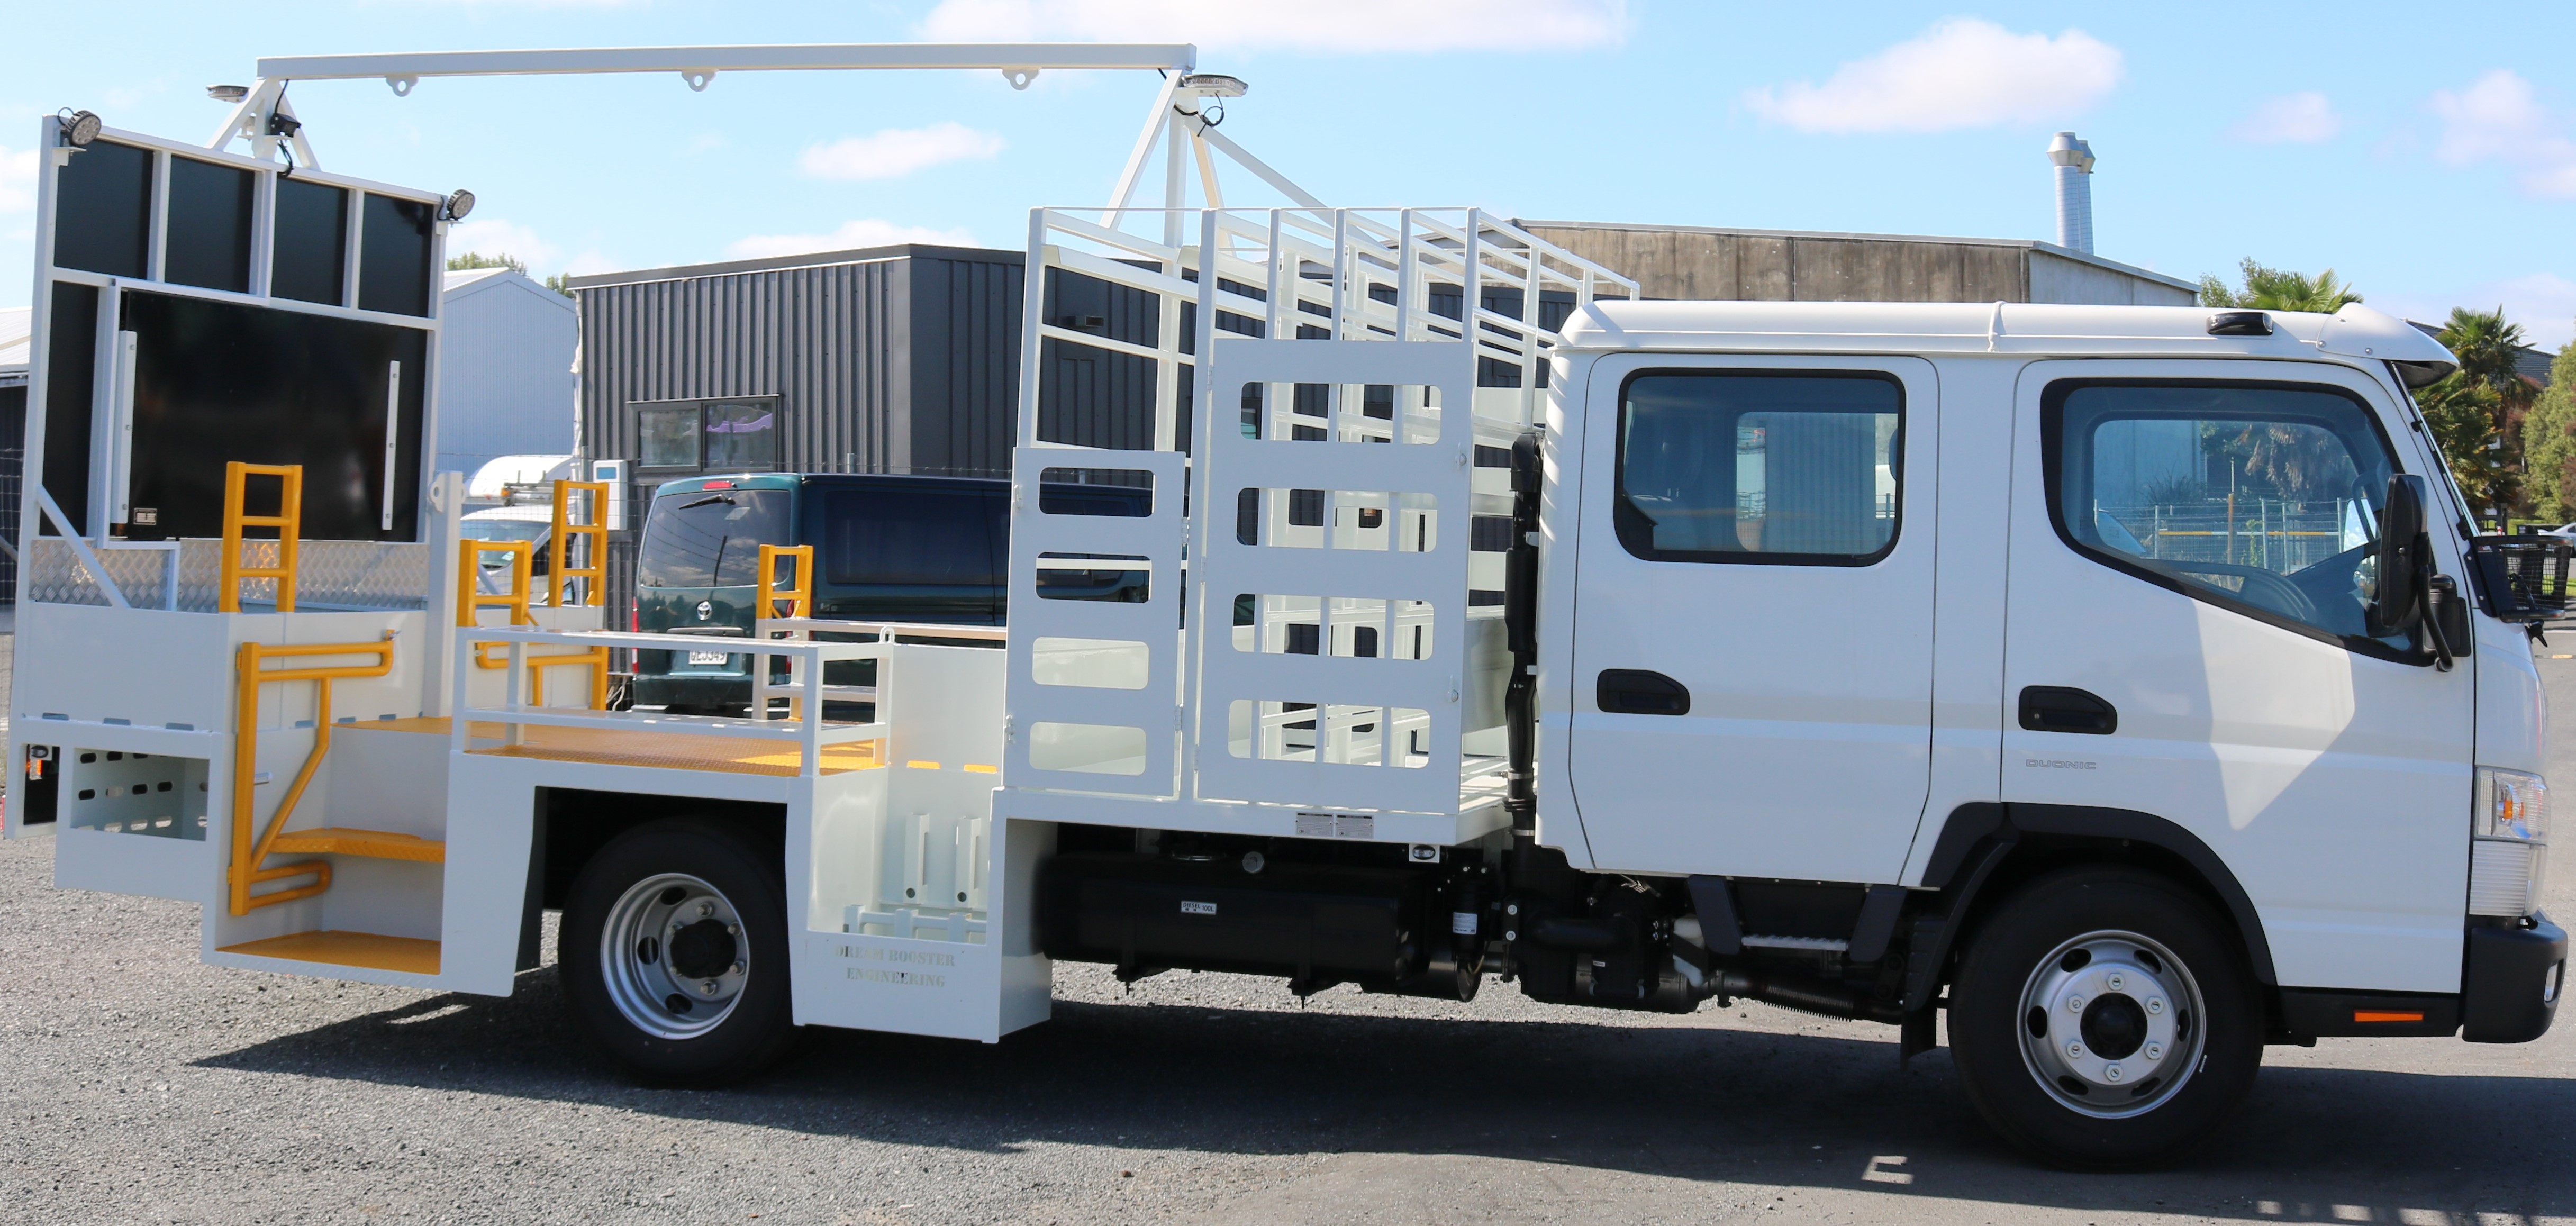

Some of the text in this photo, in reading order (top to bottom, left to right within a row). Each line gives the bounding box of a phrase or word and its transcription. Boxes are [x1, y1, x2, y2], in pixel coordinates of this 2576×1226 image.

[2026, 759, 2097, 769] DUONIC
[835, 945, 955, 967] DREAM BOOSTER
[847, 967, 945, 987] ENGINEERING
